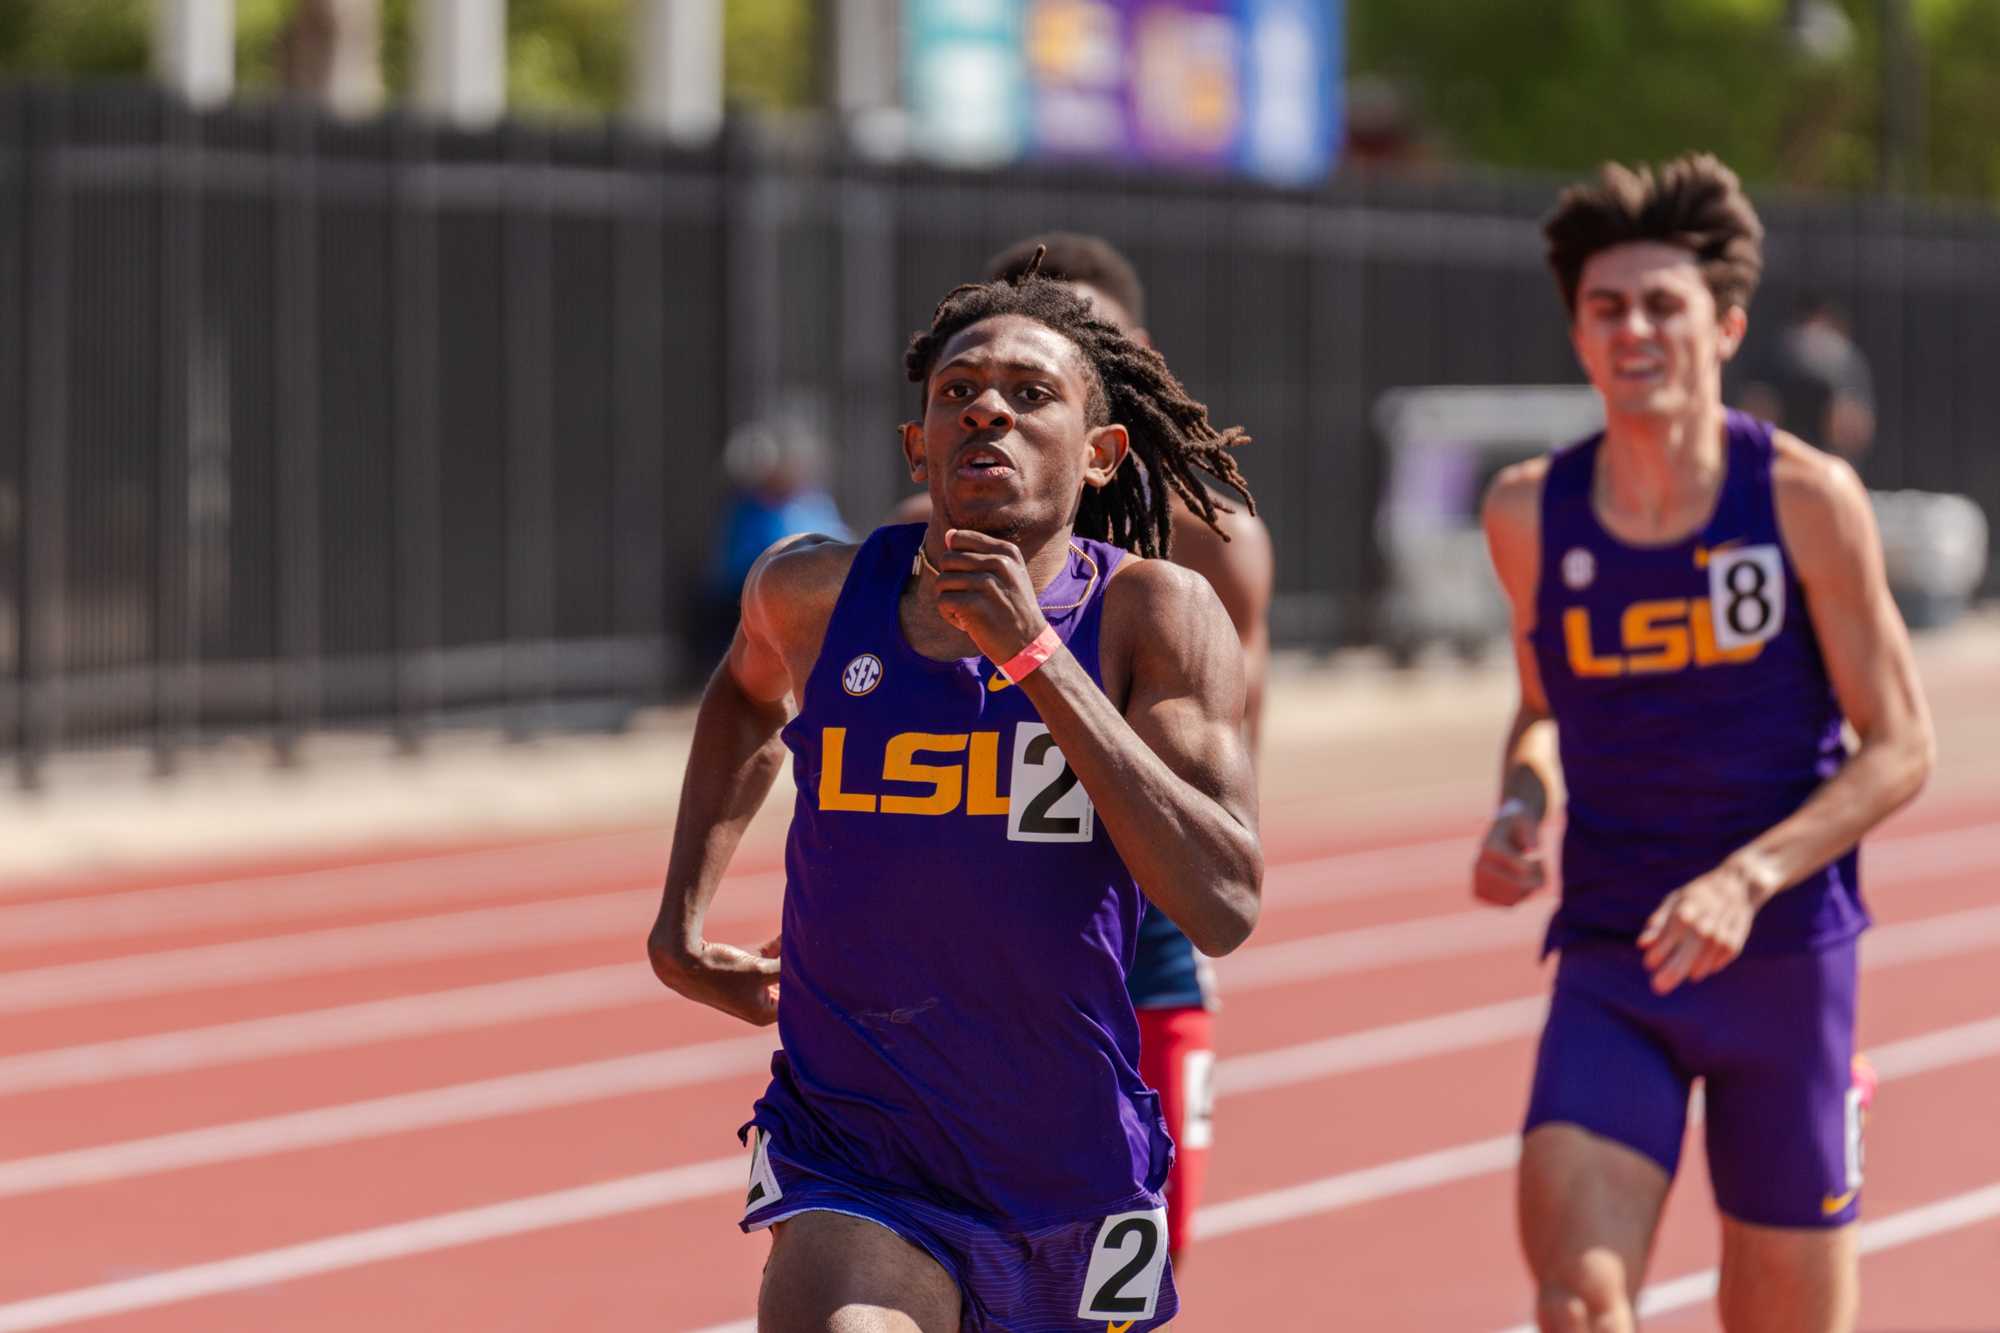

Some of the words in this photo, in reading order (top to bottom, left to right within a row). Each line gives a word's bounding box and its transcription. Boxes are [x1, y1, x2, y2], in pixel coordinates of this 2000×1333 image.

[1726, 559, 1771, 636] 8
[845, 655, 880, 693] SEC
[1018, 732, 1081, 834] 2
[1089, 1217, 1158, 1313] 2
